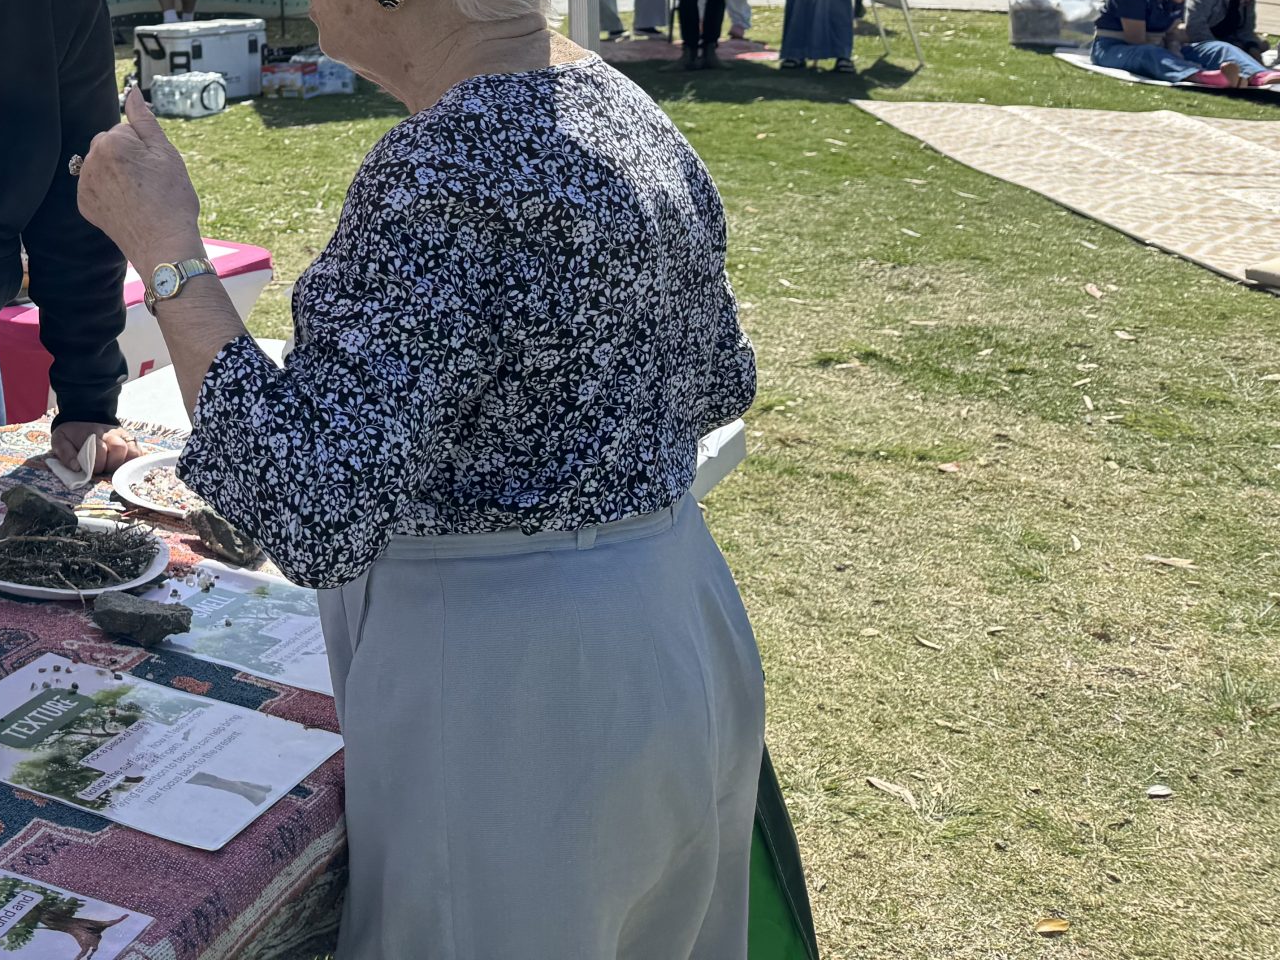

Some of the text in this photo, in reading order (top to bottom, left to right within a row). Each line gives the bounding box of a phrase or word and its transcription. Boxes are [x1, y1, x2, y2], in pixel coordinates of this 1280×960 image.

[0, 693, 79, 743] TEXTURE
[80, 779, 111, 799] Notice
[106, 768, 123, 780] the
[15, 894, 35, 911] and
